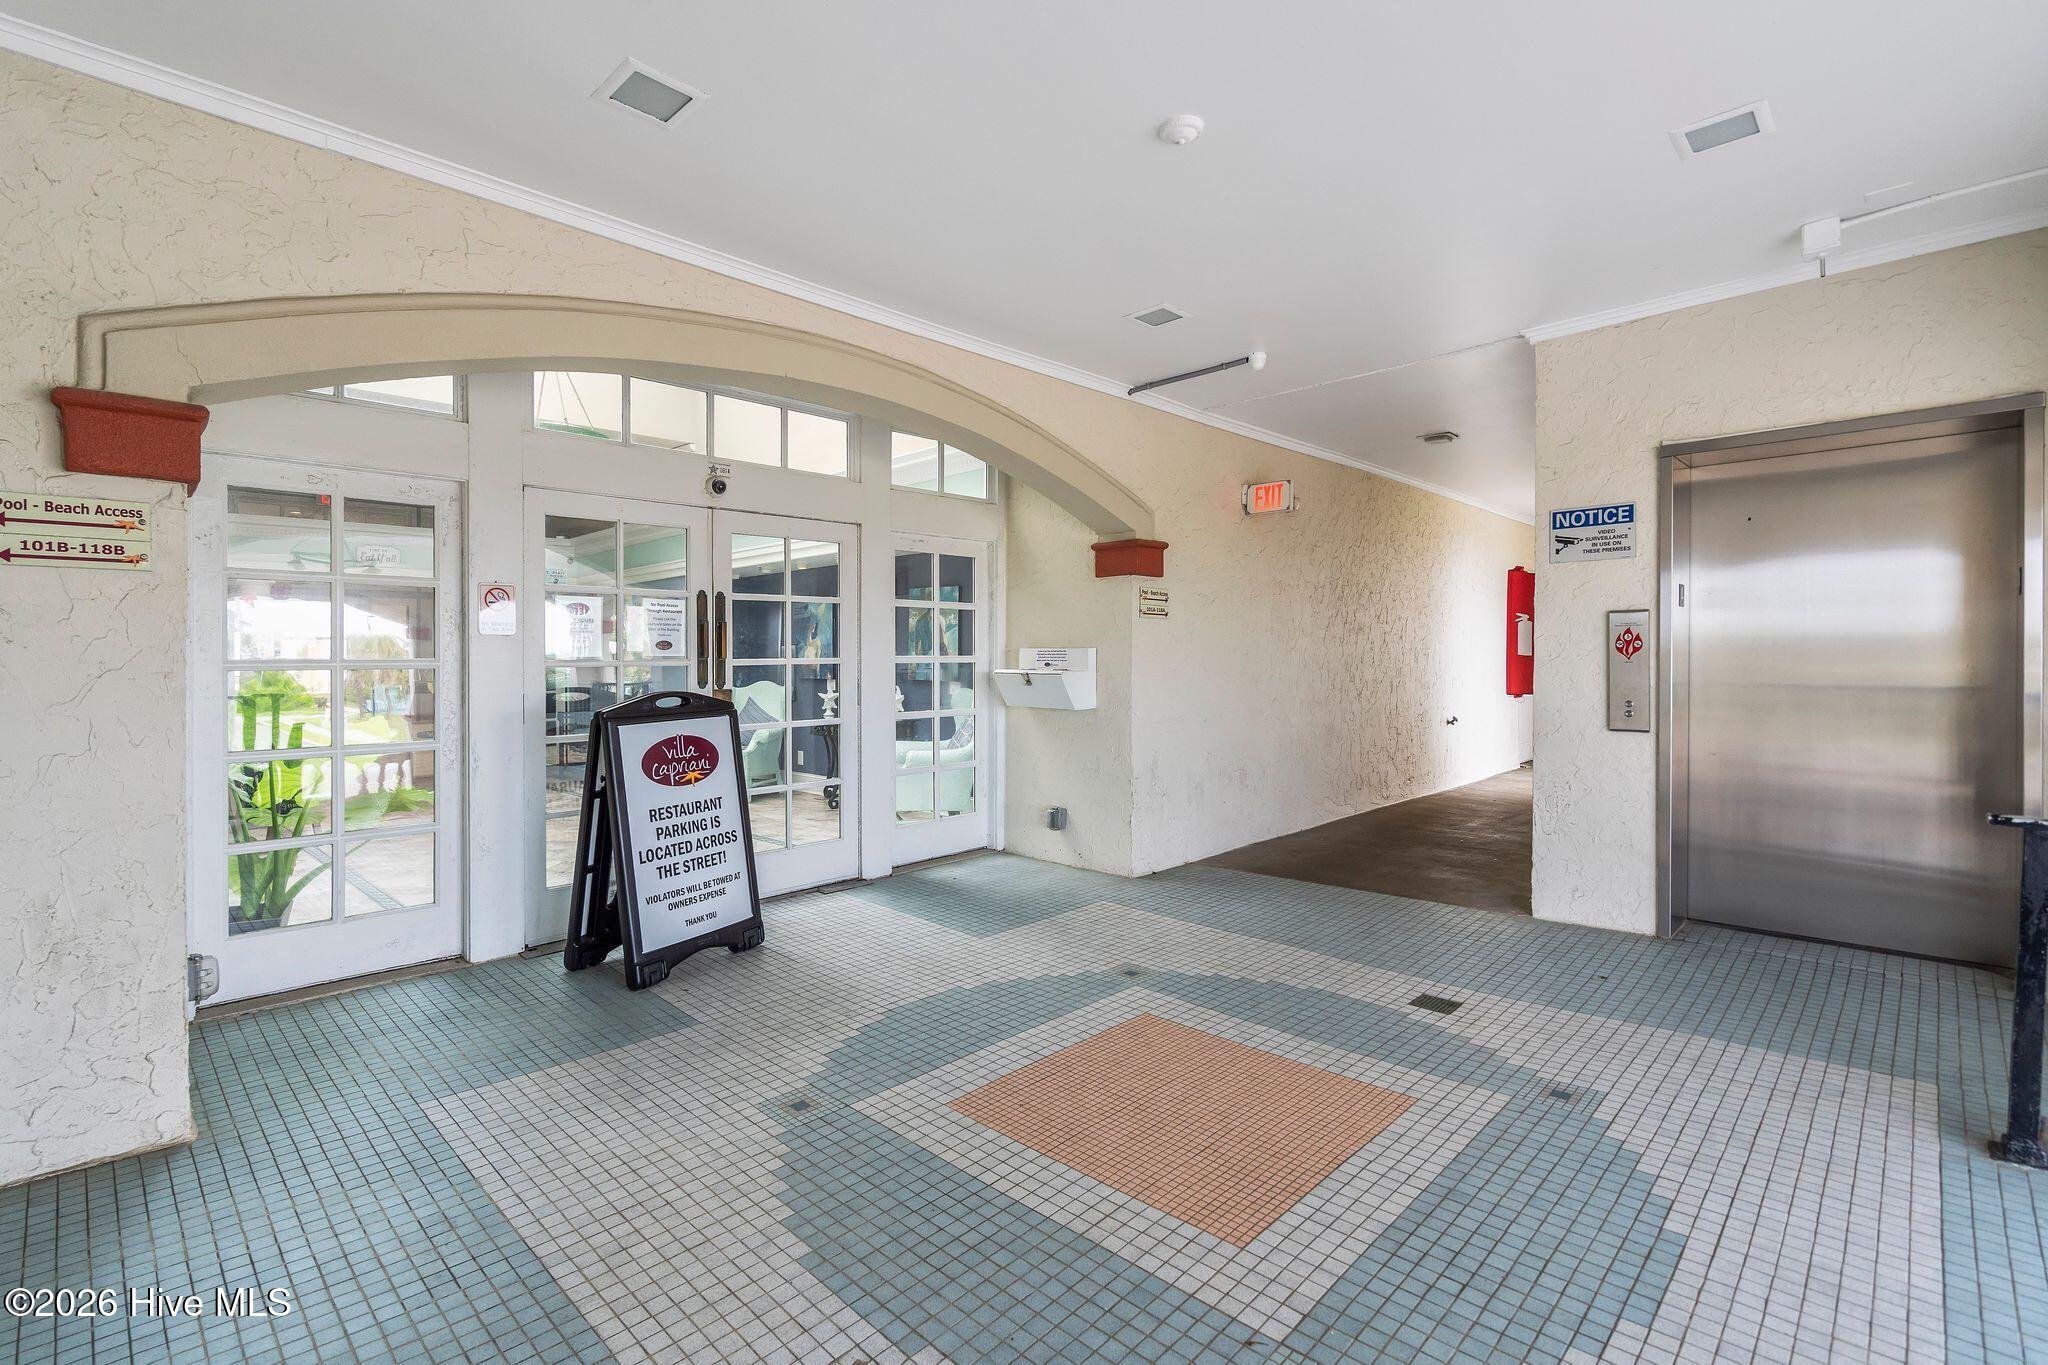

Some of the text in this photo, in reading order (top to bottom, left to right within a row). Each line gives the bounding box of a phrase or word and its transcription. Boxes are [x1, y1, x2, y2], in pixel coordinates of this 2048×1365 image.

[44, 500, 90, 515] Beach
[94, 504, 143, 519] Access
[1254, 483, 1284, 510] EXIT
[1555, 506, 1630, 528] NOTICE
[19, 539, 126, 556] 101B-118B
[1584, 533, 1629, 542] SURVEILLANCE
[1601, 545, 1632, 553] PREMISES
[648, 796, 723, 823] RESTAURANT
[655, 815, 721, 841] PARKING IS
[638, 829, 738, 865] LOCATED ACROSS
[655, 850, 727, 880] THE STREET!
[645, 871, 741, 906] VIOLATORS WILL BE TOWED AT
[667, 886, 727, 912] OWNERS EXPENSE
[684, 910, 718, 928] THANK YOU
